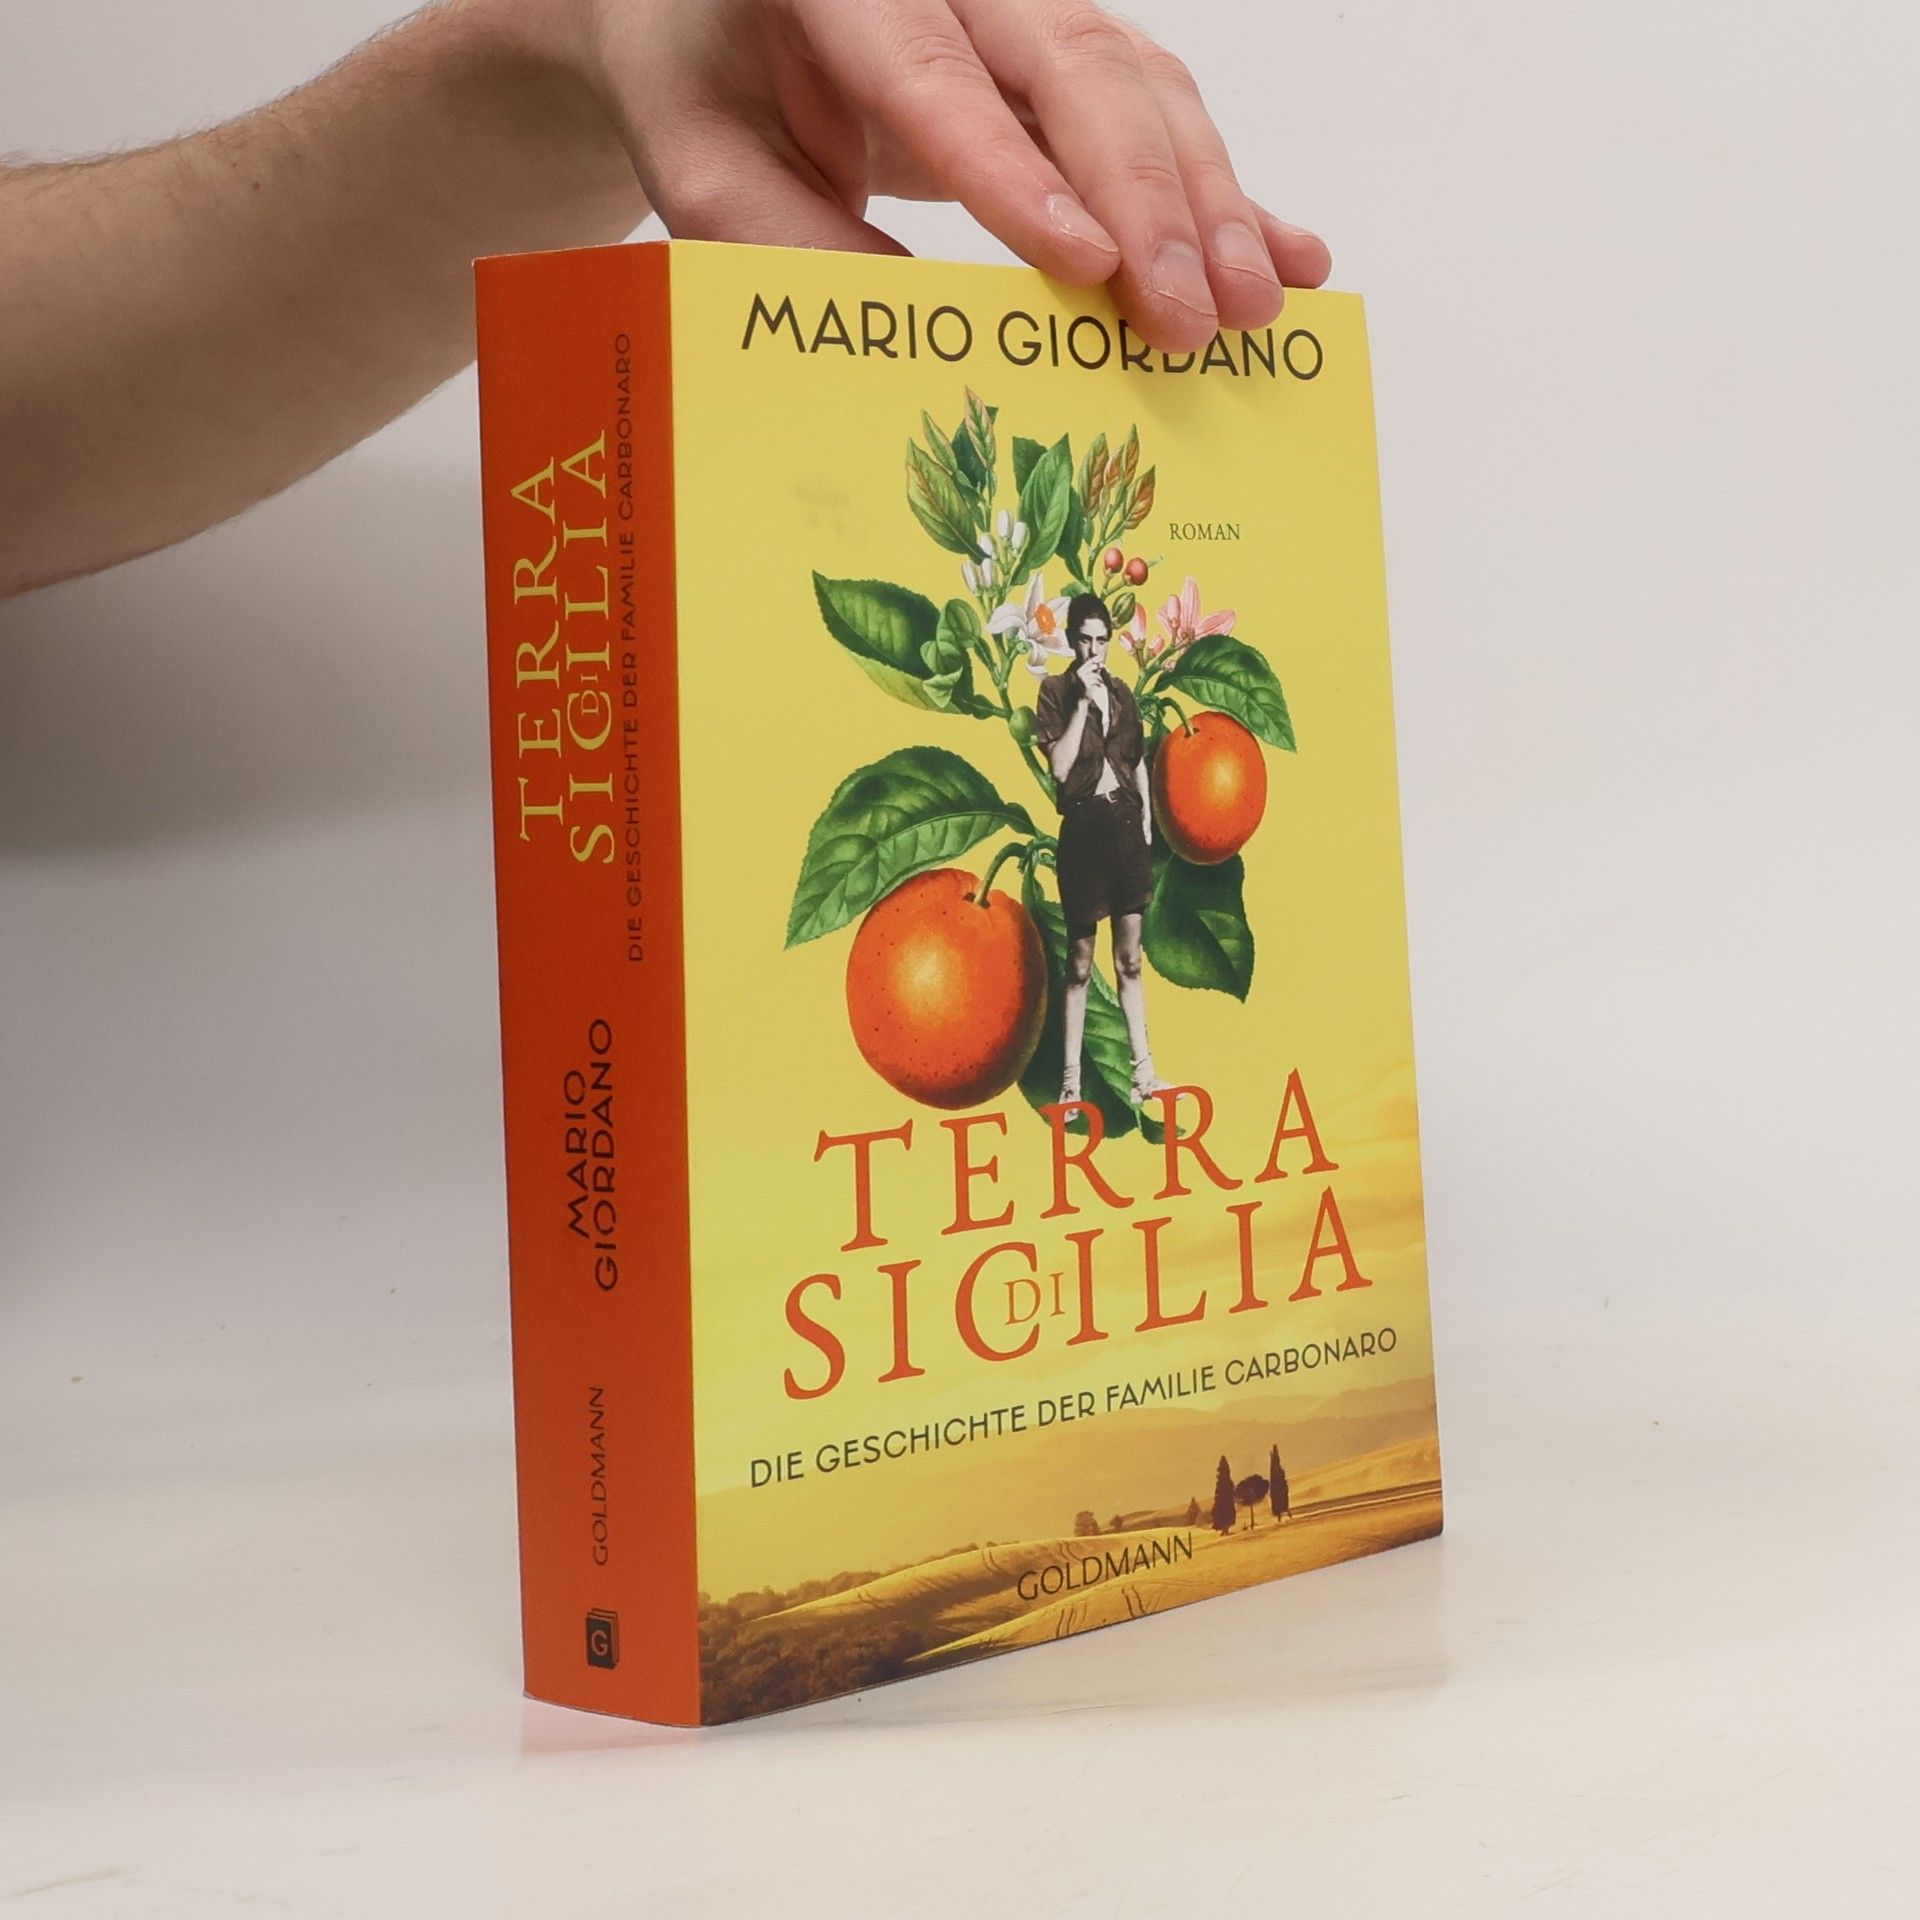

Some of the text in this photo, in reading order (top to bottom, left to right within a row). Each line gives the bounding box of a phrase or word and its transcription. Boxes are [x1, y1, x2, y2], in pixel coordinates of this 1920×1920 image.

[741, 292, 973, 362] MARIO
[1169, 522, 1240, 541] ROMAN
[510, 456, 564, 842] TERRA
[560, 428, 615, 865] SICILIA
[581, 674, 599, 716] DI
[615, 333, 643, 962] DIE GESCHICHTE DER FAMILIE CARBONARO
[563, 1070, 590, 1239] MARIO
[588, 1018, 618, 1291] GIORDANO
[814, 1067, 1340, 1253] TERRA
[783, 1185, 1374, 1400] SICILIA
[1004, 1272, 1065, 1326] DI
[589, 1387, 608, 1566] GOLDMANN
[751, 1327, 1398, 1488] DIE GESCHICHTE DER FAMILIE CARBONARO
[591, 1630, 608, 1656] G
[1017, 1532, 1193, 1600] GOLDMANN
